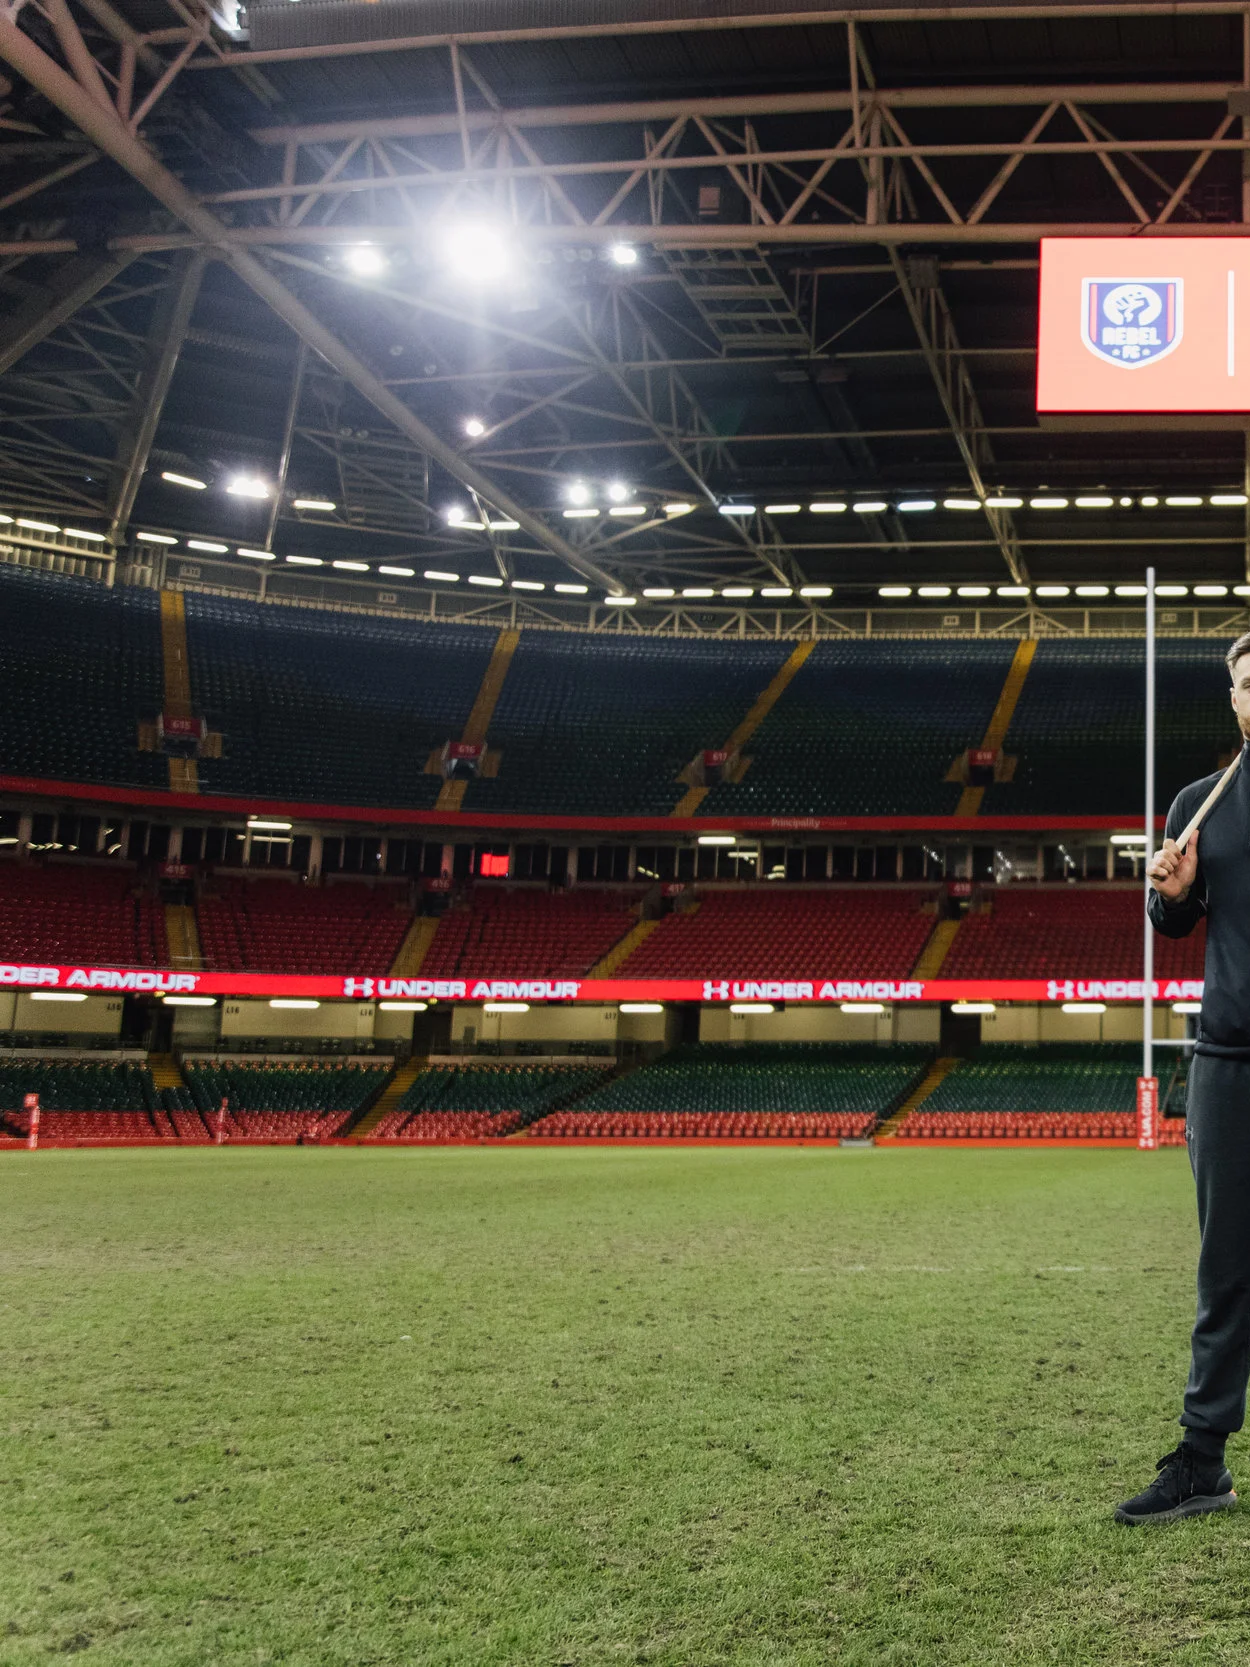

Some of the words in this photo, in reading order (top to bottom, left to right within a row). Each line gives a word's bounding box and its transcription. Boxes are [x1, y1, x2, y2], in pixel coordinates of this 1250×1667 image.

[771, 817, 820, 829] Principality
[66, 969, 197, 990] ARMOUR
[378, 980, 466, 997] UNDER
[471, 982, 579, 998] ARMOUR
[732, 982, 813, 998] UNDER
[819, 982, 923, 998] ARMOUR
